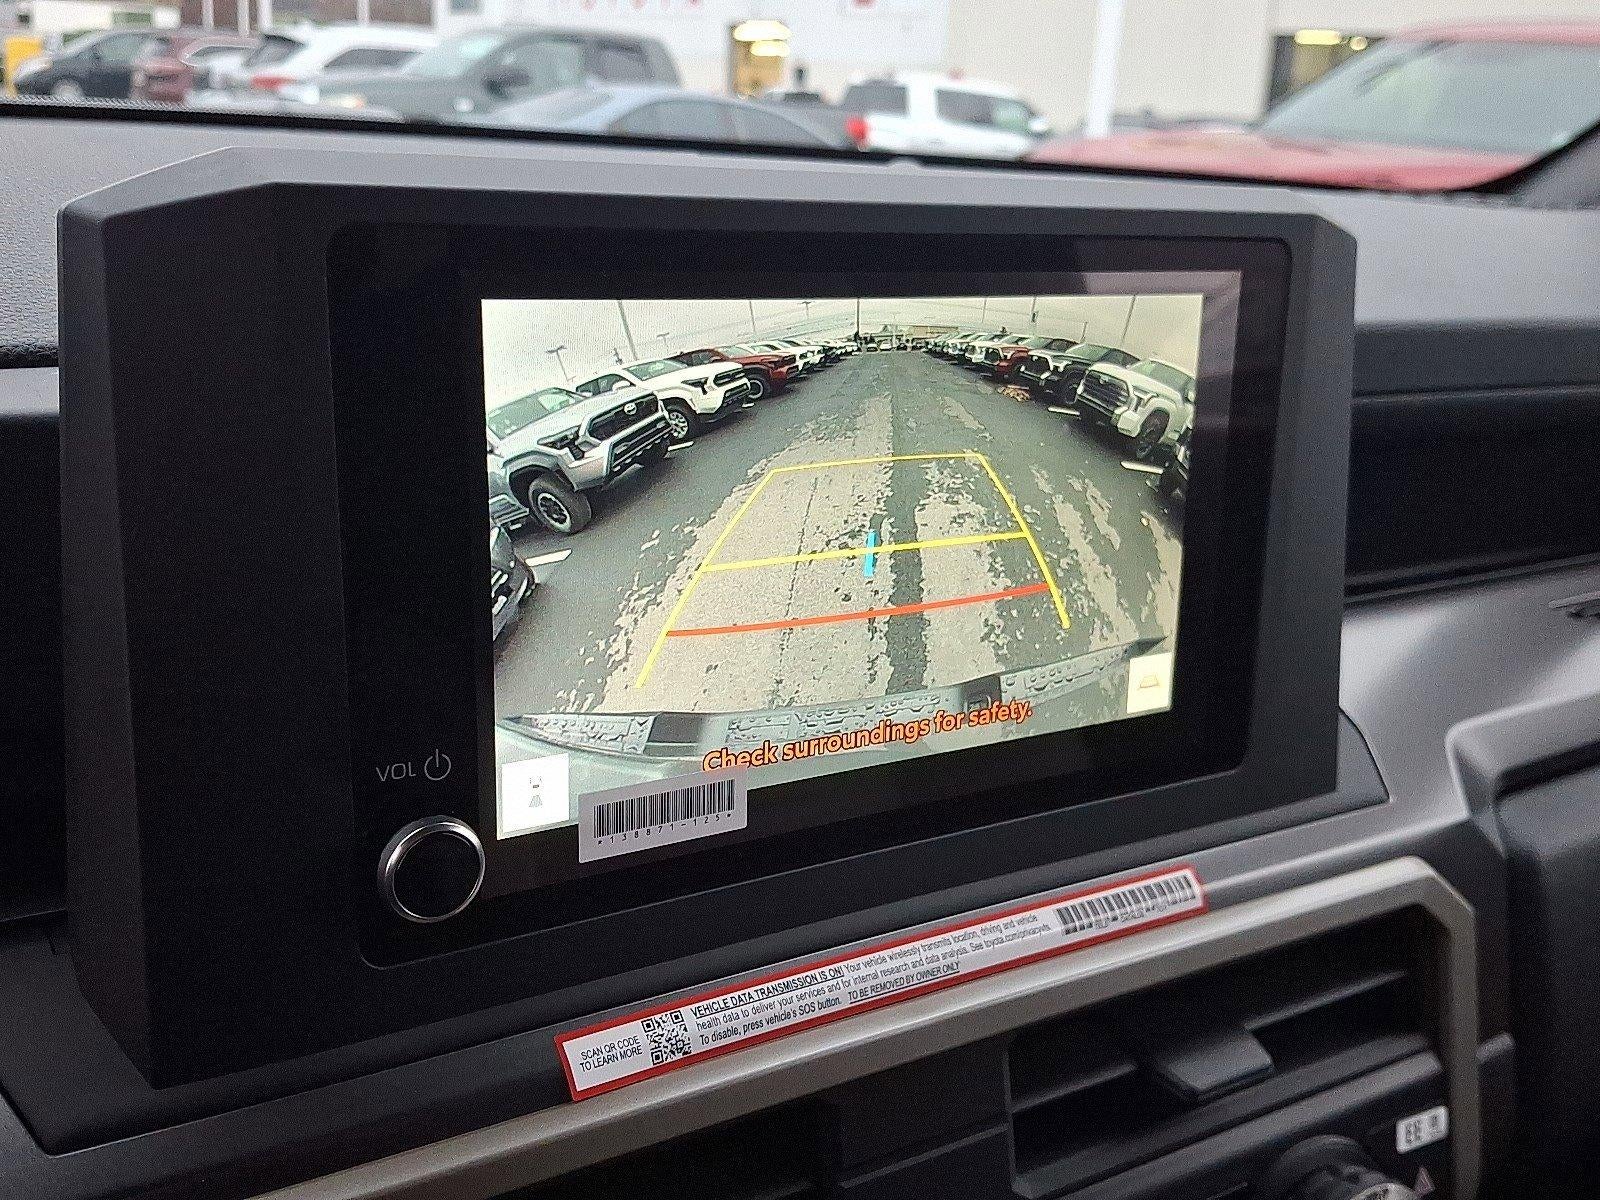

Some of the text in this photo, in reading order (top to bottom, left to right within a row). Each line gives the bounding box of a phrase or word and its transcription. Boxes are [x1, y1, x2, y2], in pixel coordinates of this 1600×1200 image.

[702, 700, 1034, 772] Check surroundings for safety.
[376, 762, 417, 781] VOL
[690, 912, 1039, 1018] VEHICLE DATA TRANSMISSION IS ON! Your vehicle wirelessly transmits location, driving and vehicle
[695, 1015, 722, 1032] health
[722, 1010, 741, 1024] data
[740, 1007, 751, 1018] to
[751, 1000, 777, 1016] deliver
[776, 995, 797, 1010] your
[795, 986, 827, 1003] services
[826, 980, 843, 994] and
[841, 977, 852, 989] for
[852, 968, 880, 985] internal
[878, 961, 912, 978] research
[910, 956, 926, 969] and
[924, 951, 942, 965] data
[969, 941, 985, 953] See
[848, 961, 960, 1003] TO BE REMOVED BY OWNER ONLY
[699, 996, 843, 1047] To disable, press vehicle's SOS button.
[579, 1045, 643, 1073] TO LEARN MORE
[580, 1035, 641, 1062] SCAN QR CODE
